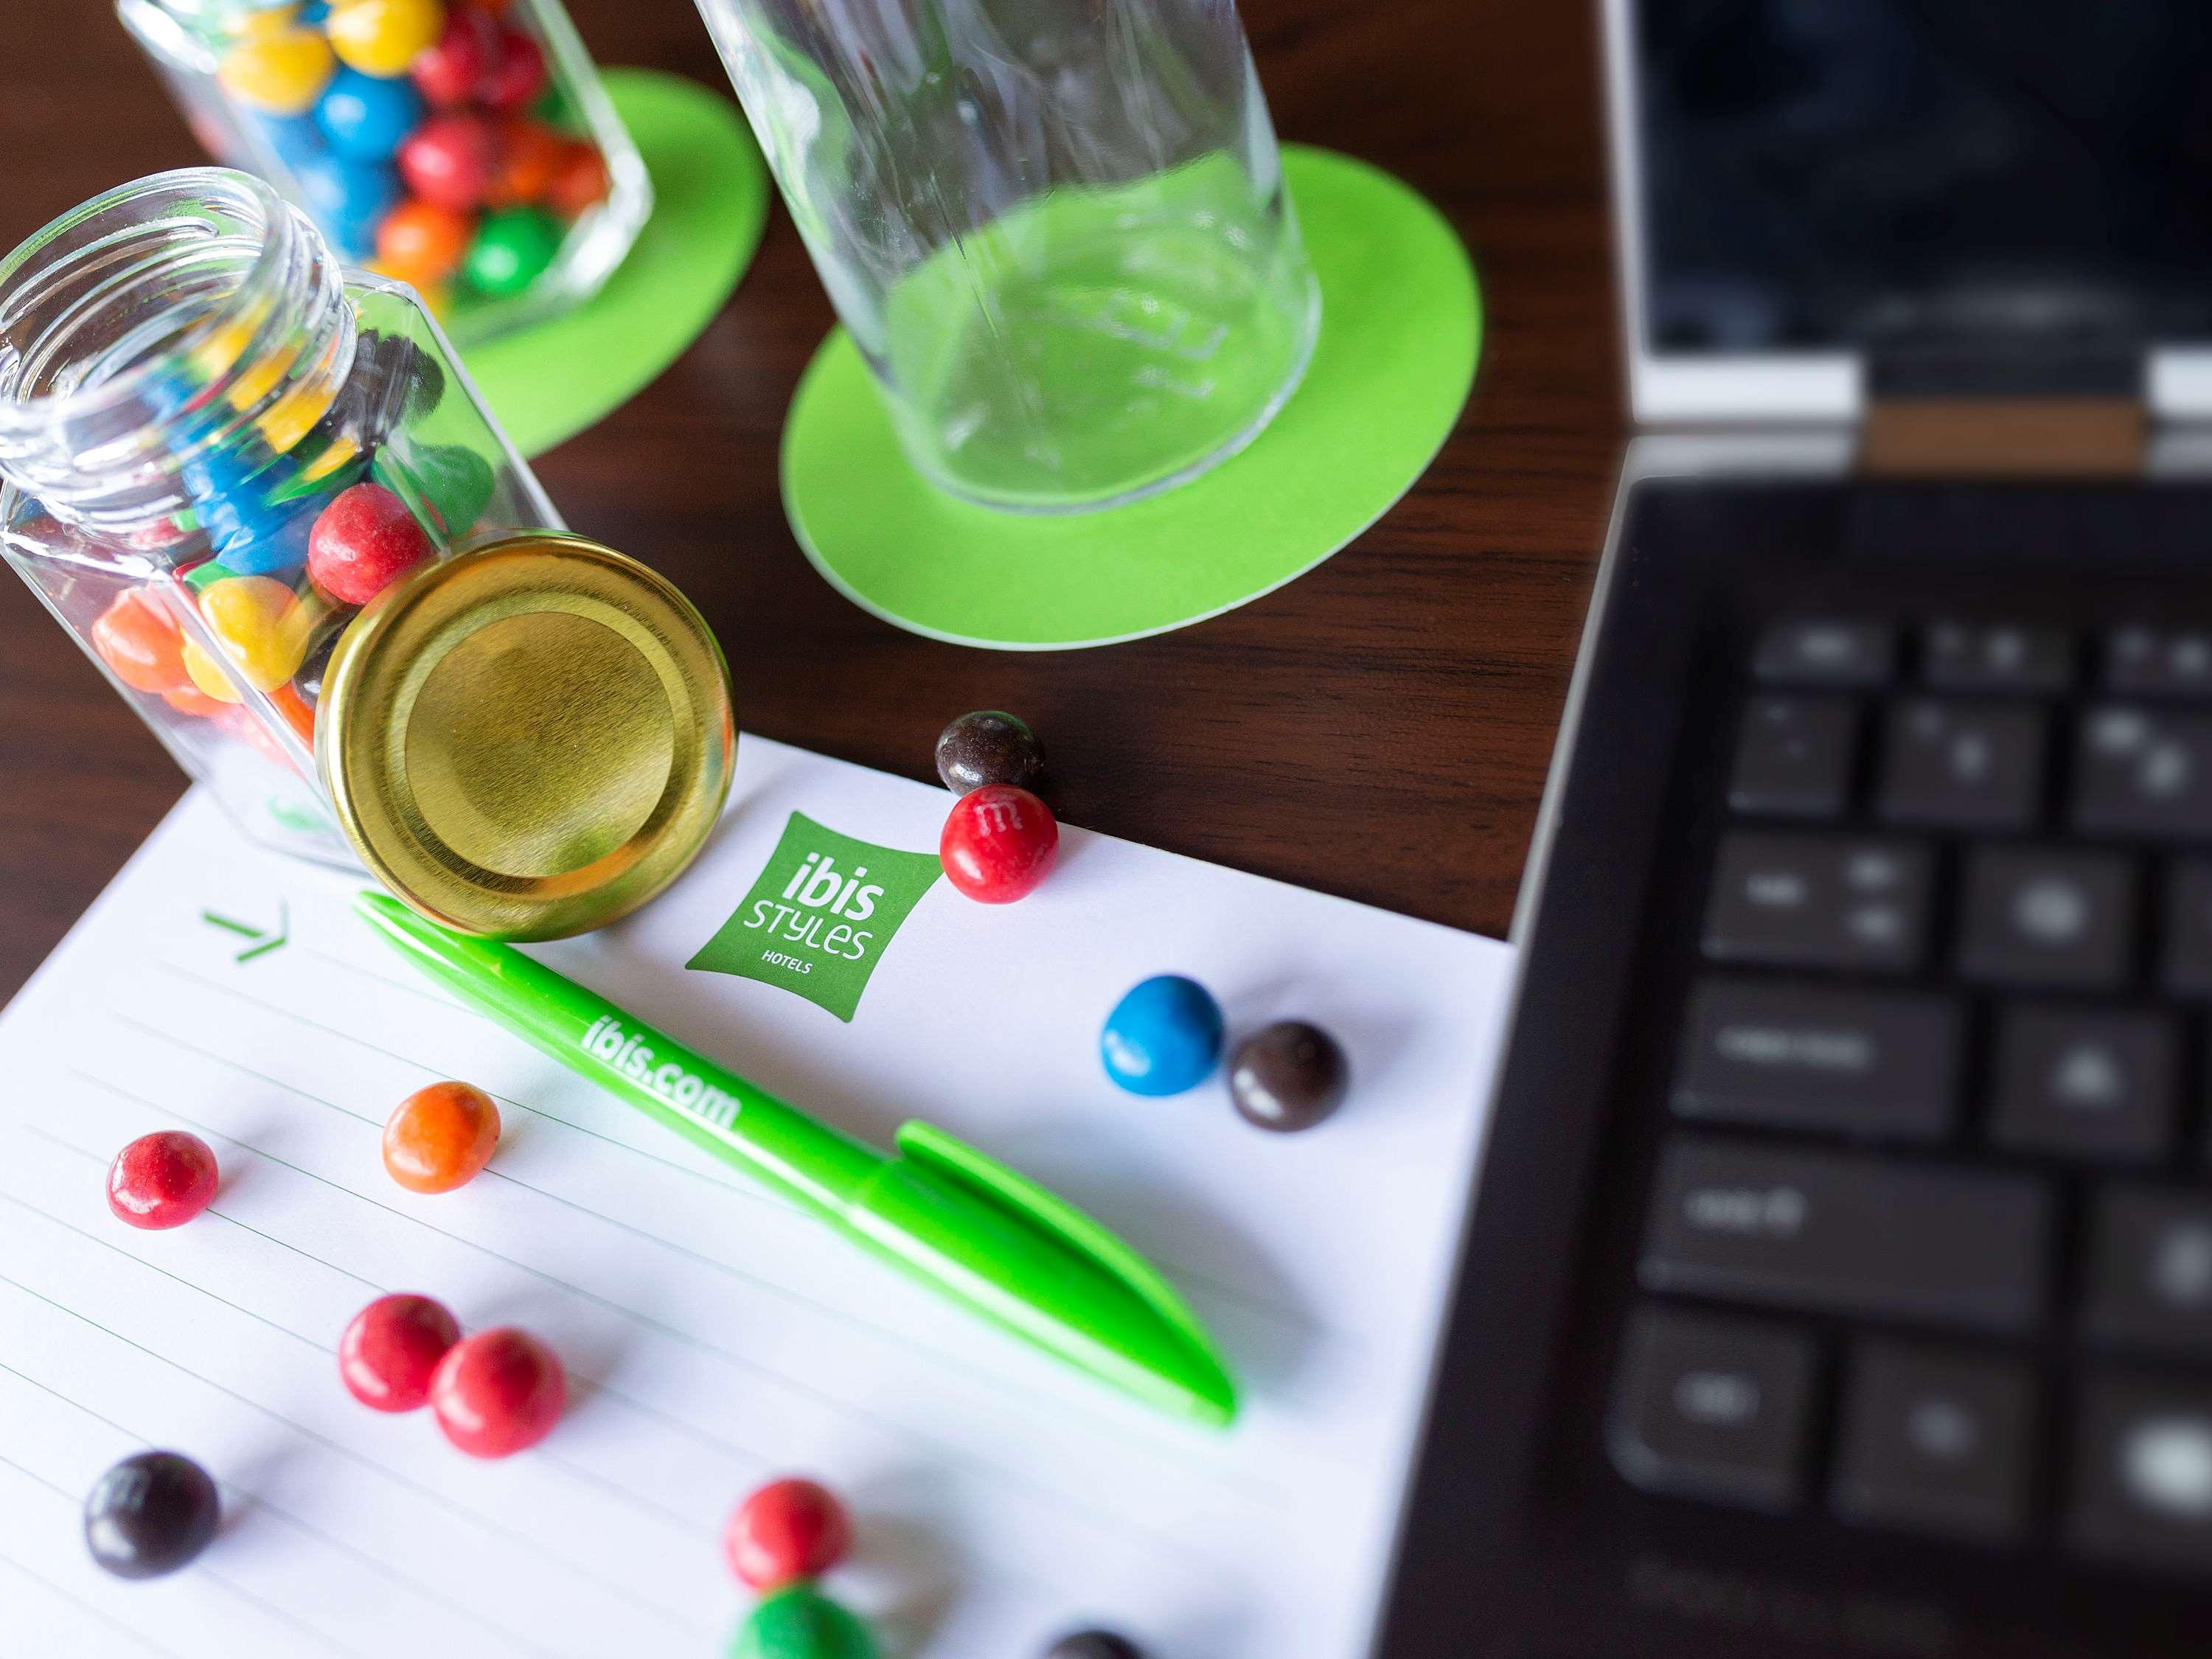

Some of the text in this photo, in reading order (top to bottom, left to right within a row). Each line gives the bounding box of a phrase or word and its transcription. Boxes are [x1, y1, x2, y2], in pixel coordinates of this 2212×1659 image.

[973, 801, 1023, 838] m
[782, 852, 884, 921] ibis
[761, 949, 813, 974] HOTELS
[582, 1015, 742, 1130] ibis.com
